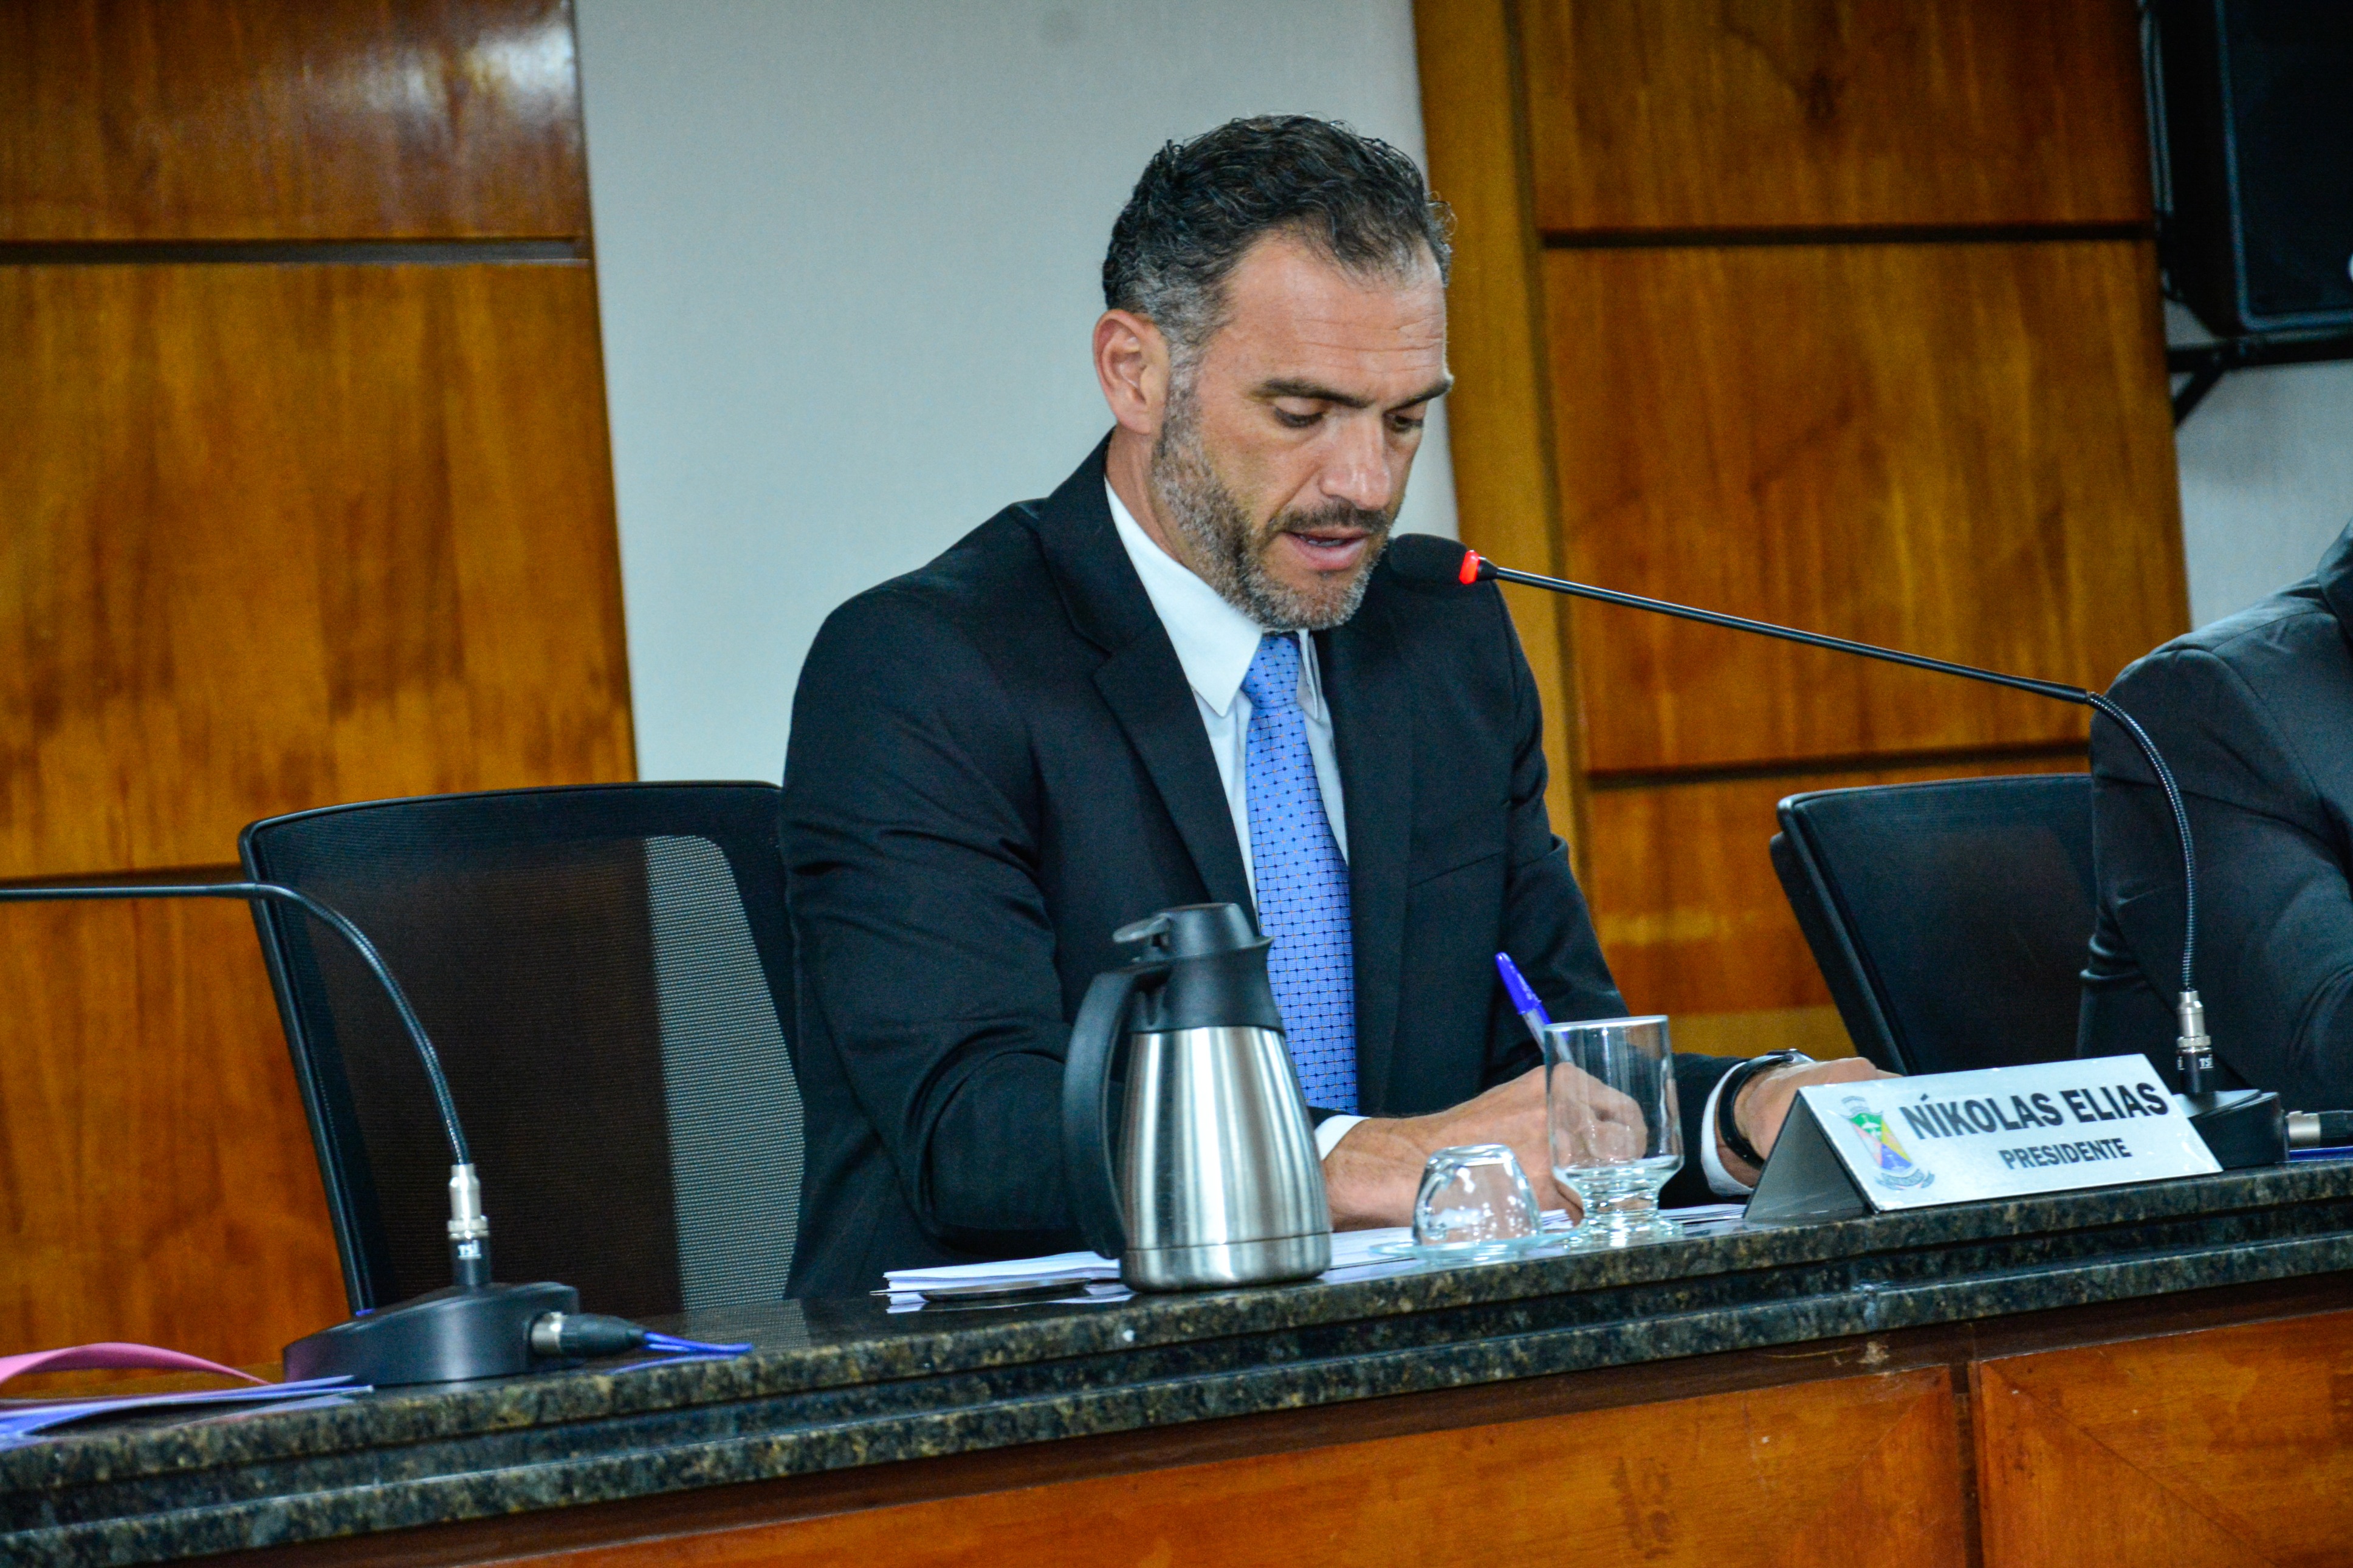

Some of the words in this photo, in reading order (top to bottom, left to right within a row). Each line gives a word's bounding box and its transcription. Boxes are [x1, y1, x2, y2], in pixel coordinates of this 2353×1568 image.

[1898, 1092, 2064, 1140] NÍKOLAS
[2058, 1082, 2169, 1123] ELIAS
[1998, 1137, 2132, 1170] PRESIDENTE
